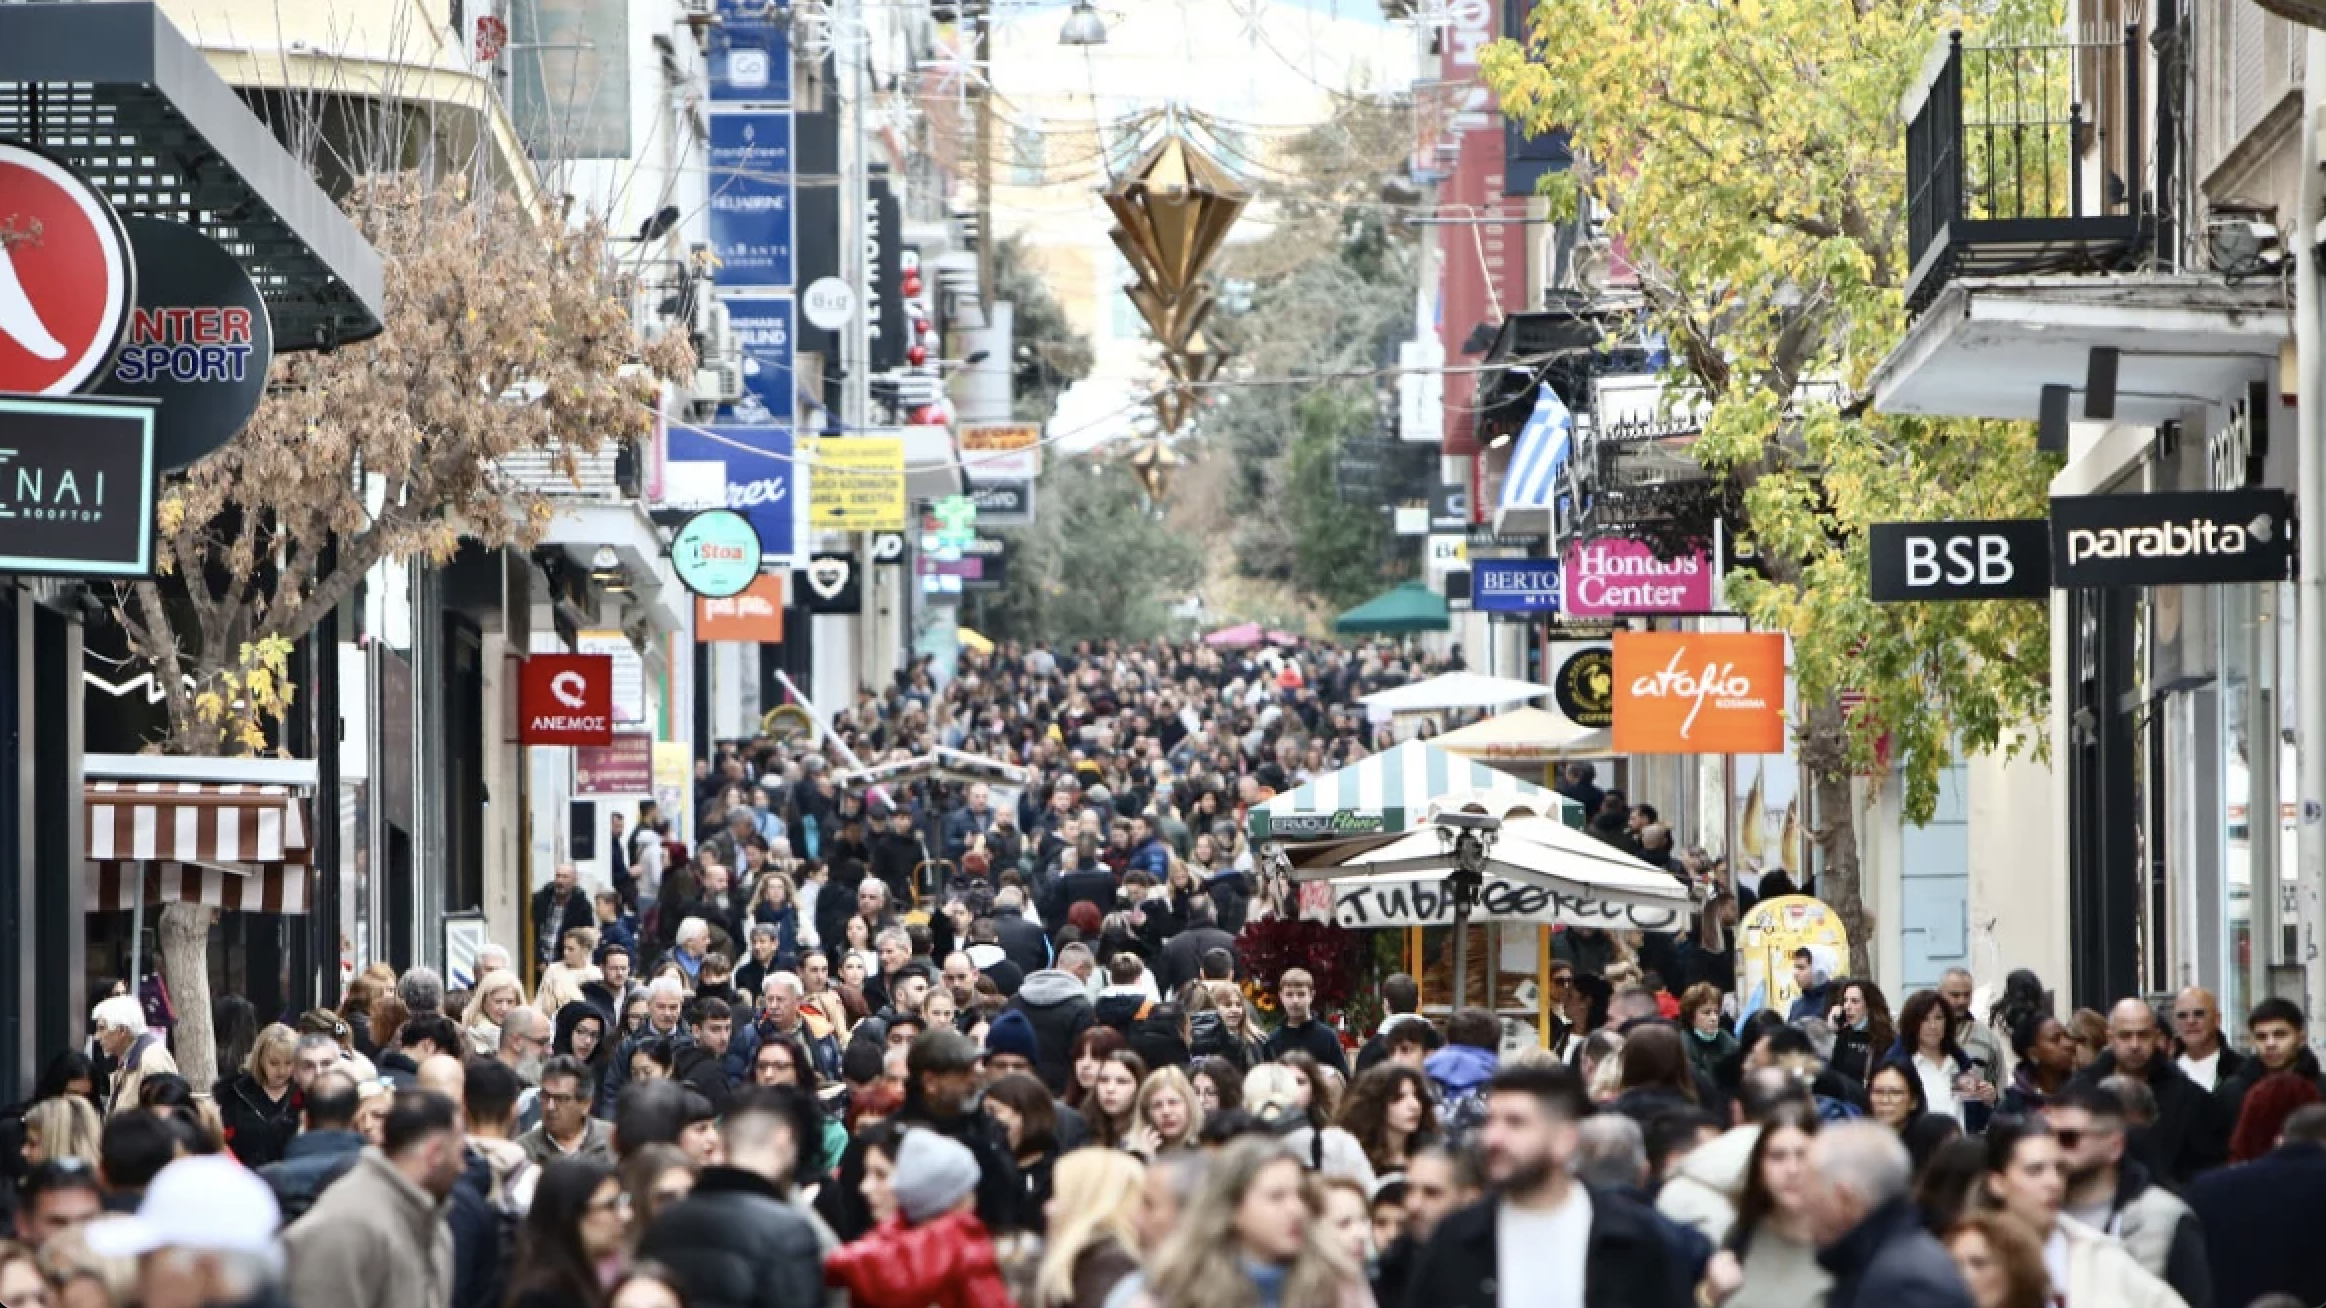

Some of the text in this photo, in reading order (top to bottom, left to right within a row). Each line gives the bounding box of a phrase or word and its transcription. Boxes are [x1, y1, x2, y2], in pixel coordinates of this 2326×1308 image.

[131, 306, 252, 344] NTER
[116, 344, 252, 382] SPORT
[23, 507, 103, 522] ROOFTOP
[1905, 535, 2015, 587] BSB
[2068, 519, 2247, 566] parabita
[1577, 575, 1687, 607] Center
[531, 716, 606, 731] ΑΝΕΜΟΣ
